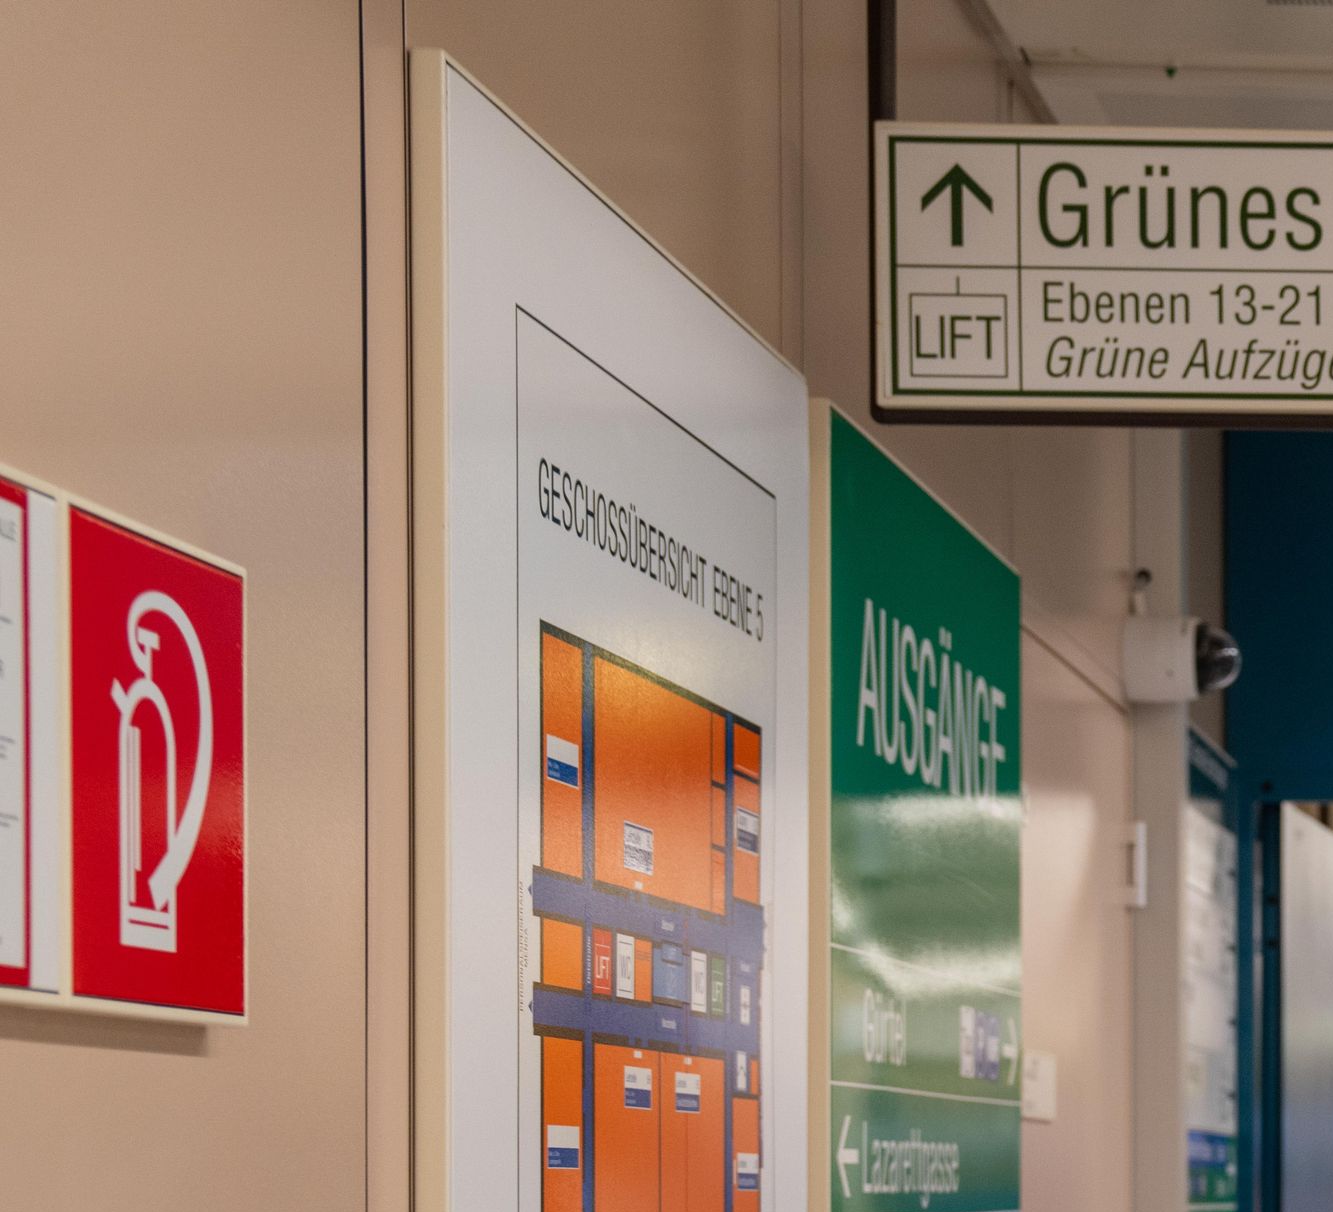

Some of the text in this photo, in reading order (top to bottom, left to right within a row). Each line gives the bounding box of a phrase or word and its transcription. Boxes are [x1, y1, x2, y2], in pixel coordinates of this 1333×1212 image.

[1037, 162, 1323, 249] Grünes
[913, 314, 1002, 360] LIFT
[1042, 281, 1324, 326] Ebenen 13-21
[1045, 335, 1170, 381] Grüne
[538, 457, 764, 642] GESCHOSSÜBERSICHT EBENE 5
[856, 596, 1007, 815] AUSGÄNGE
[861, 1119, 960, 1210] Lazarettgasse
